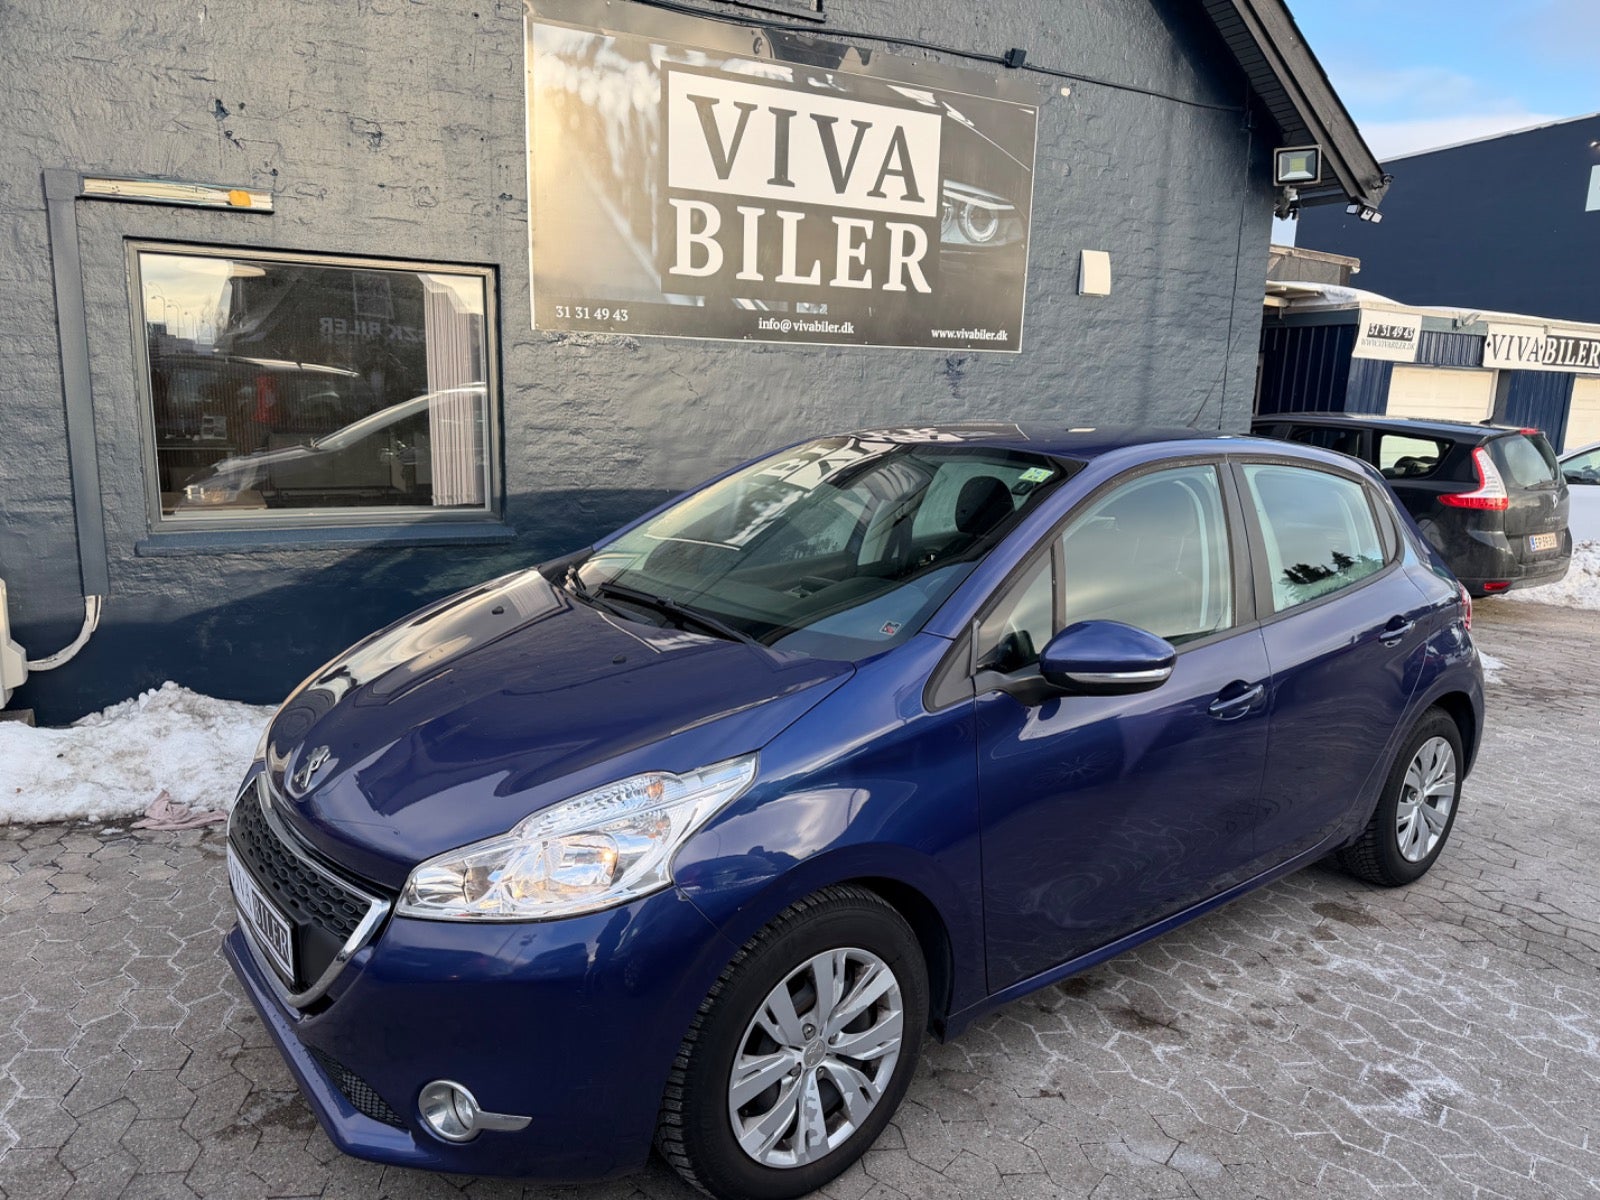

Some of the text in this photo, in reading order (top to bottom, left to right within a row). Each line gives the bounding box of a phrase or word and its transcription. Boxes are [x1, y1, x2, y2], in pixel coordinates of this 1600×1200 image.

[687, 94, 925, 203] VIVA
[669, 198, 931, 293] BILER
[555, 305, 628, 321] 31 31 49 43
[758, 317, 855, 334] info@vivabiler.dk
[931, 328, 1008, 341] www.vivabiler.dk
[1491, 333, 1600, 367] VIVA BILER
[253, 893, 290, 962] BILER
